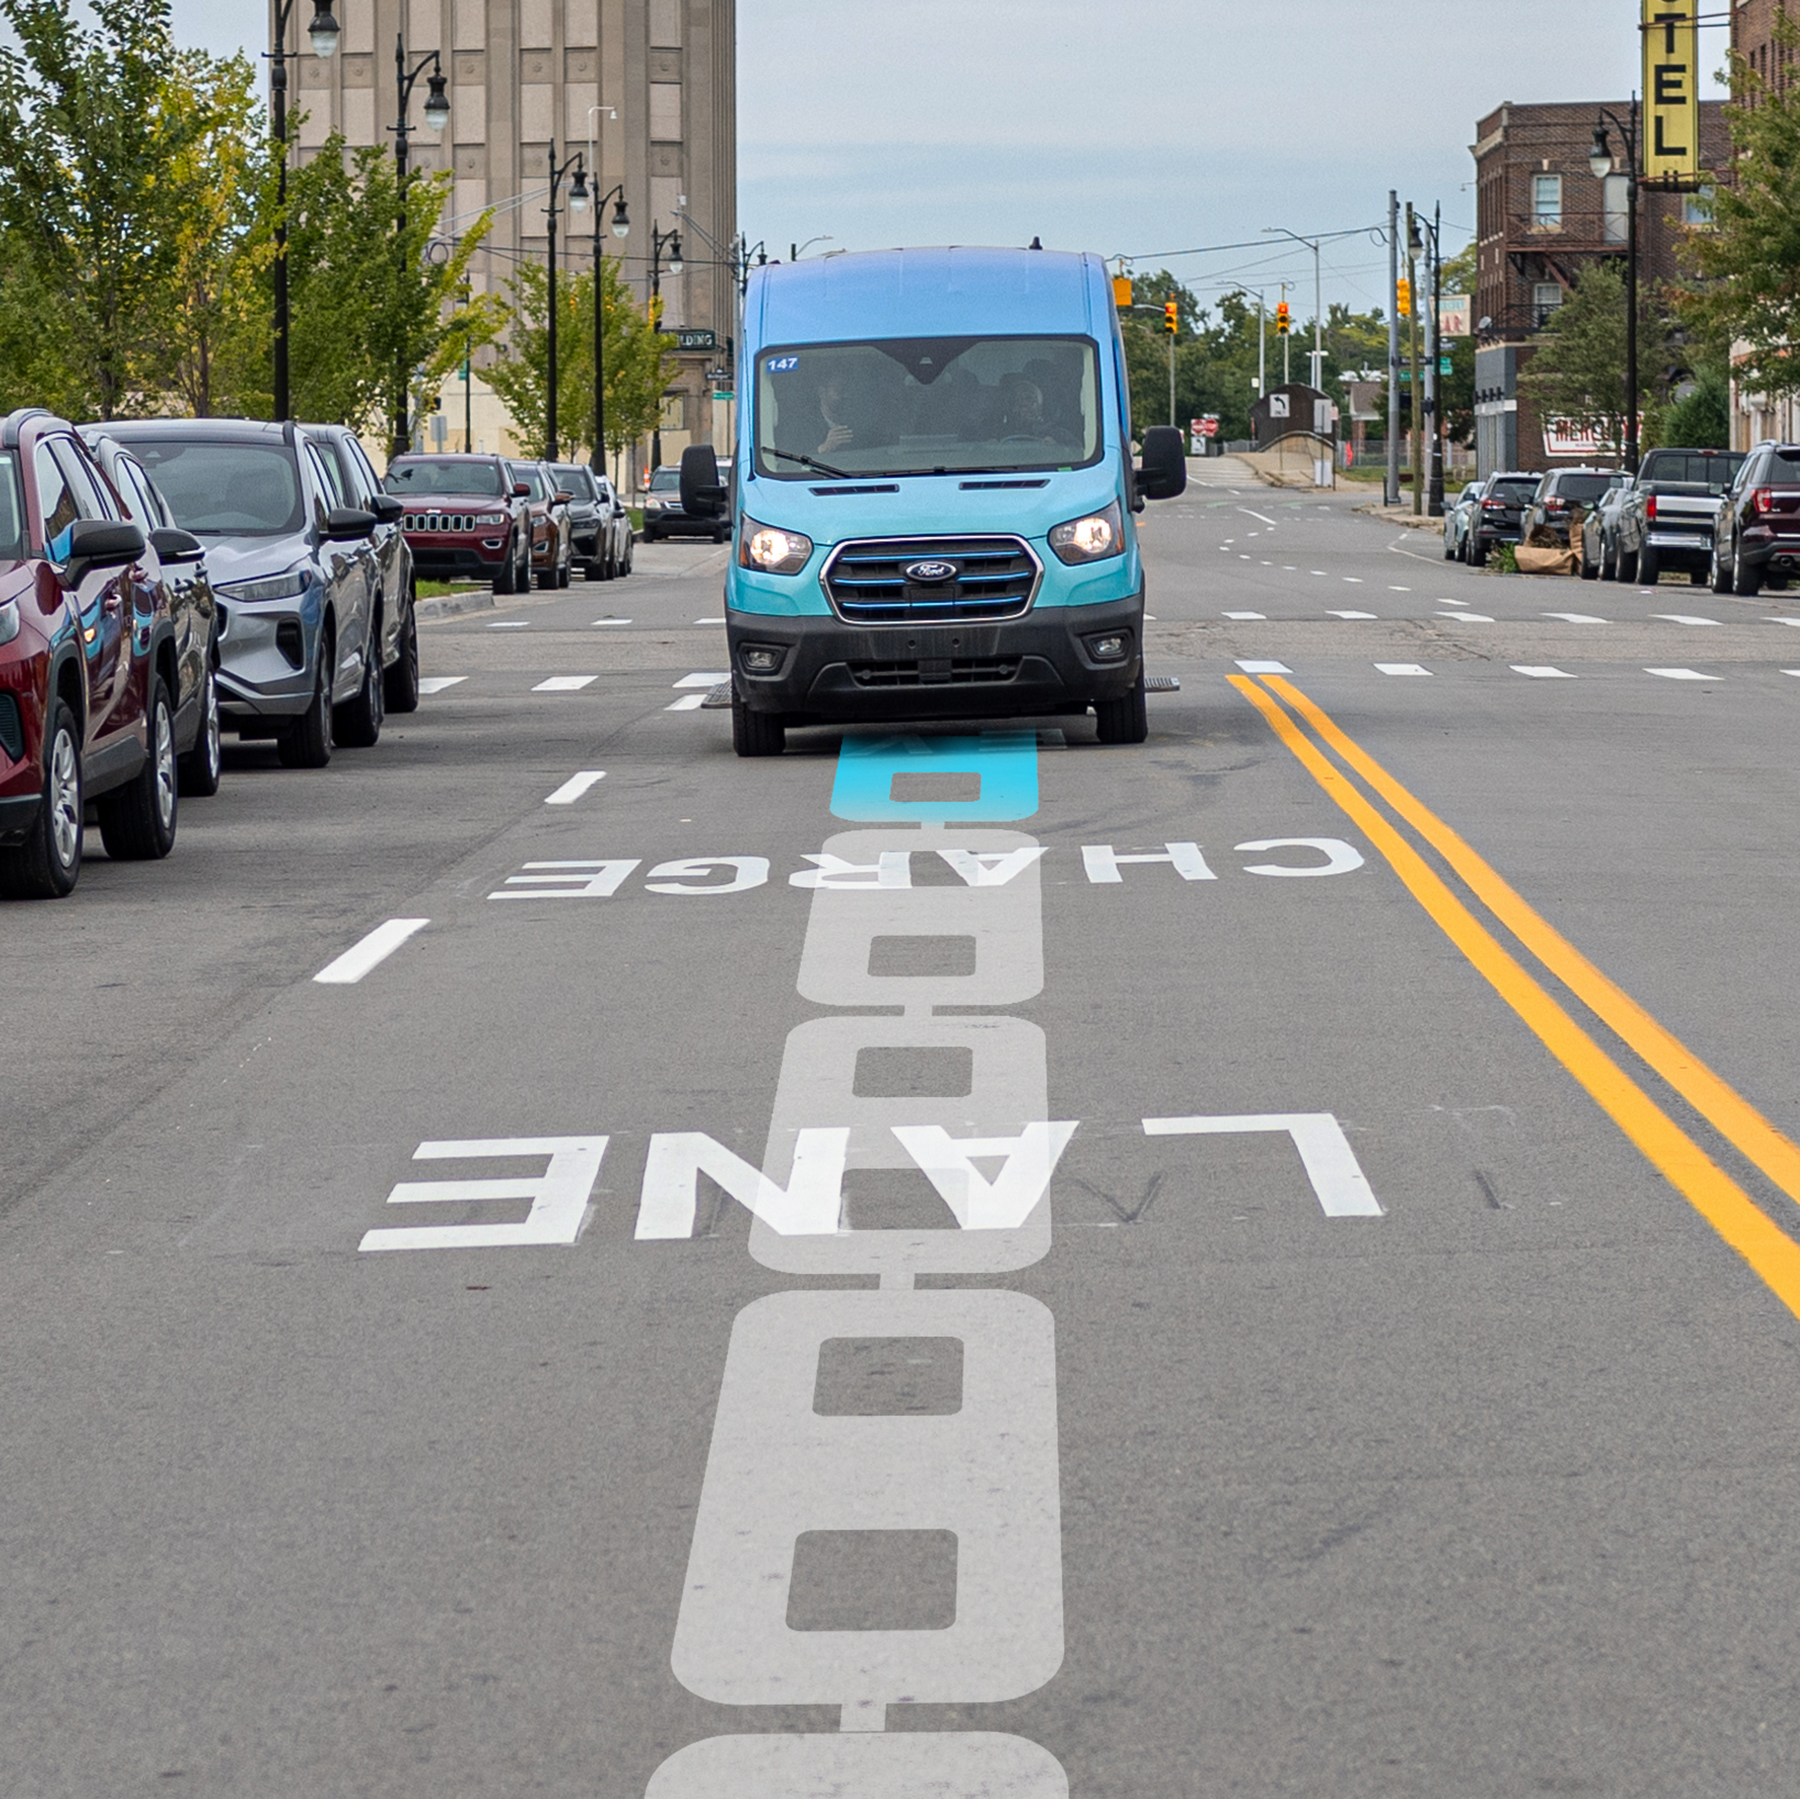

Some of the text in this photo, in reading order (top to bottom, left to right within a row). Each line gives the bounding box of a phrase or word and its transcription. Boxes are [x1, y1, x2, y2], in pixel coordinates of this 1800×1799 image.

[1654, 0, 1687, 156] TEL
[676, 334, 712, 346] LDING
[768, 357, 798, 371] 147
[917, 563, 945, 576] Ford
[488, 838, 1364, 899] CHARGE
[358, 1113, 1385, 1251] LANE
